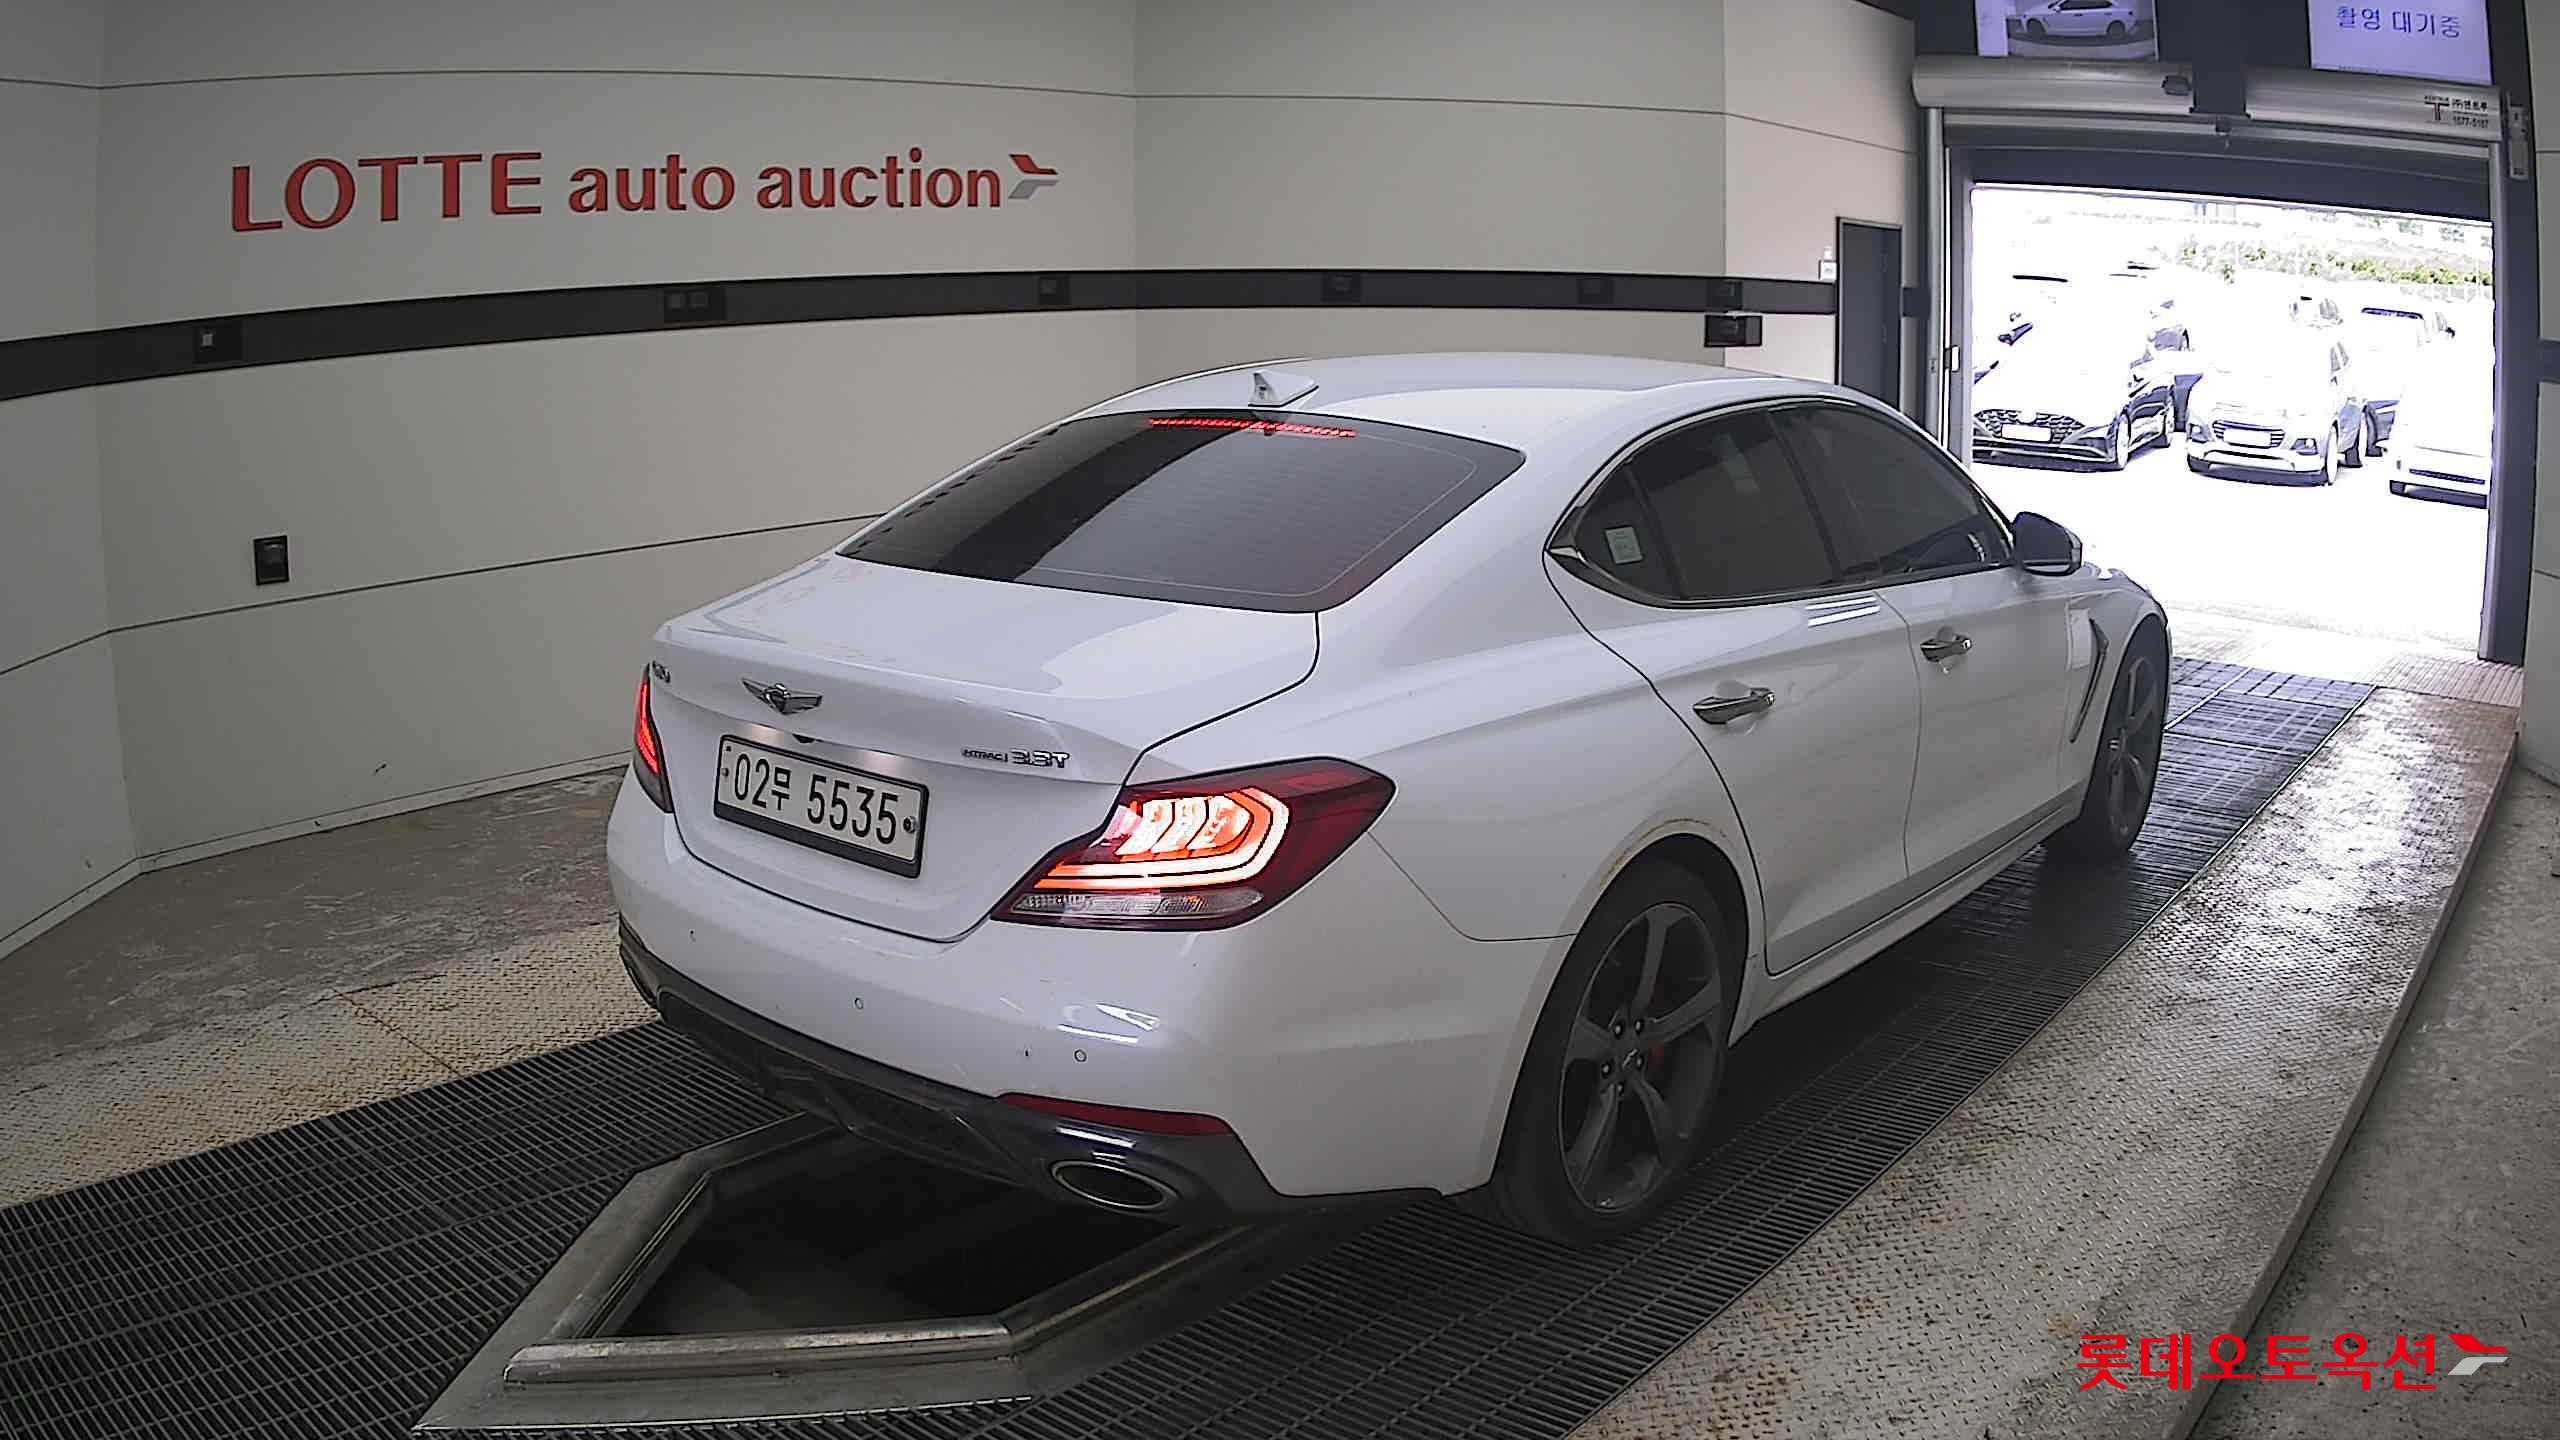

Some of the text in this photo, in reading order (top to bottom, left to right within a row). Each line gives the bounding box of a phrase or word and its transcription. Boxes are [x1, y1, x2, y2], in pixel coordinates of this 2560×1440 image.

[2337, 6, 2460, 39] 촬영 대기중
[232, 147, 1001, 232] LOTTE auto auction
[734, 753, 898, 845] 02무 5535
